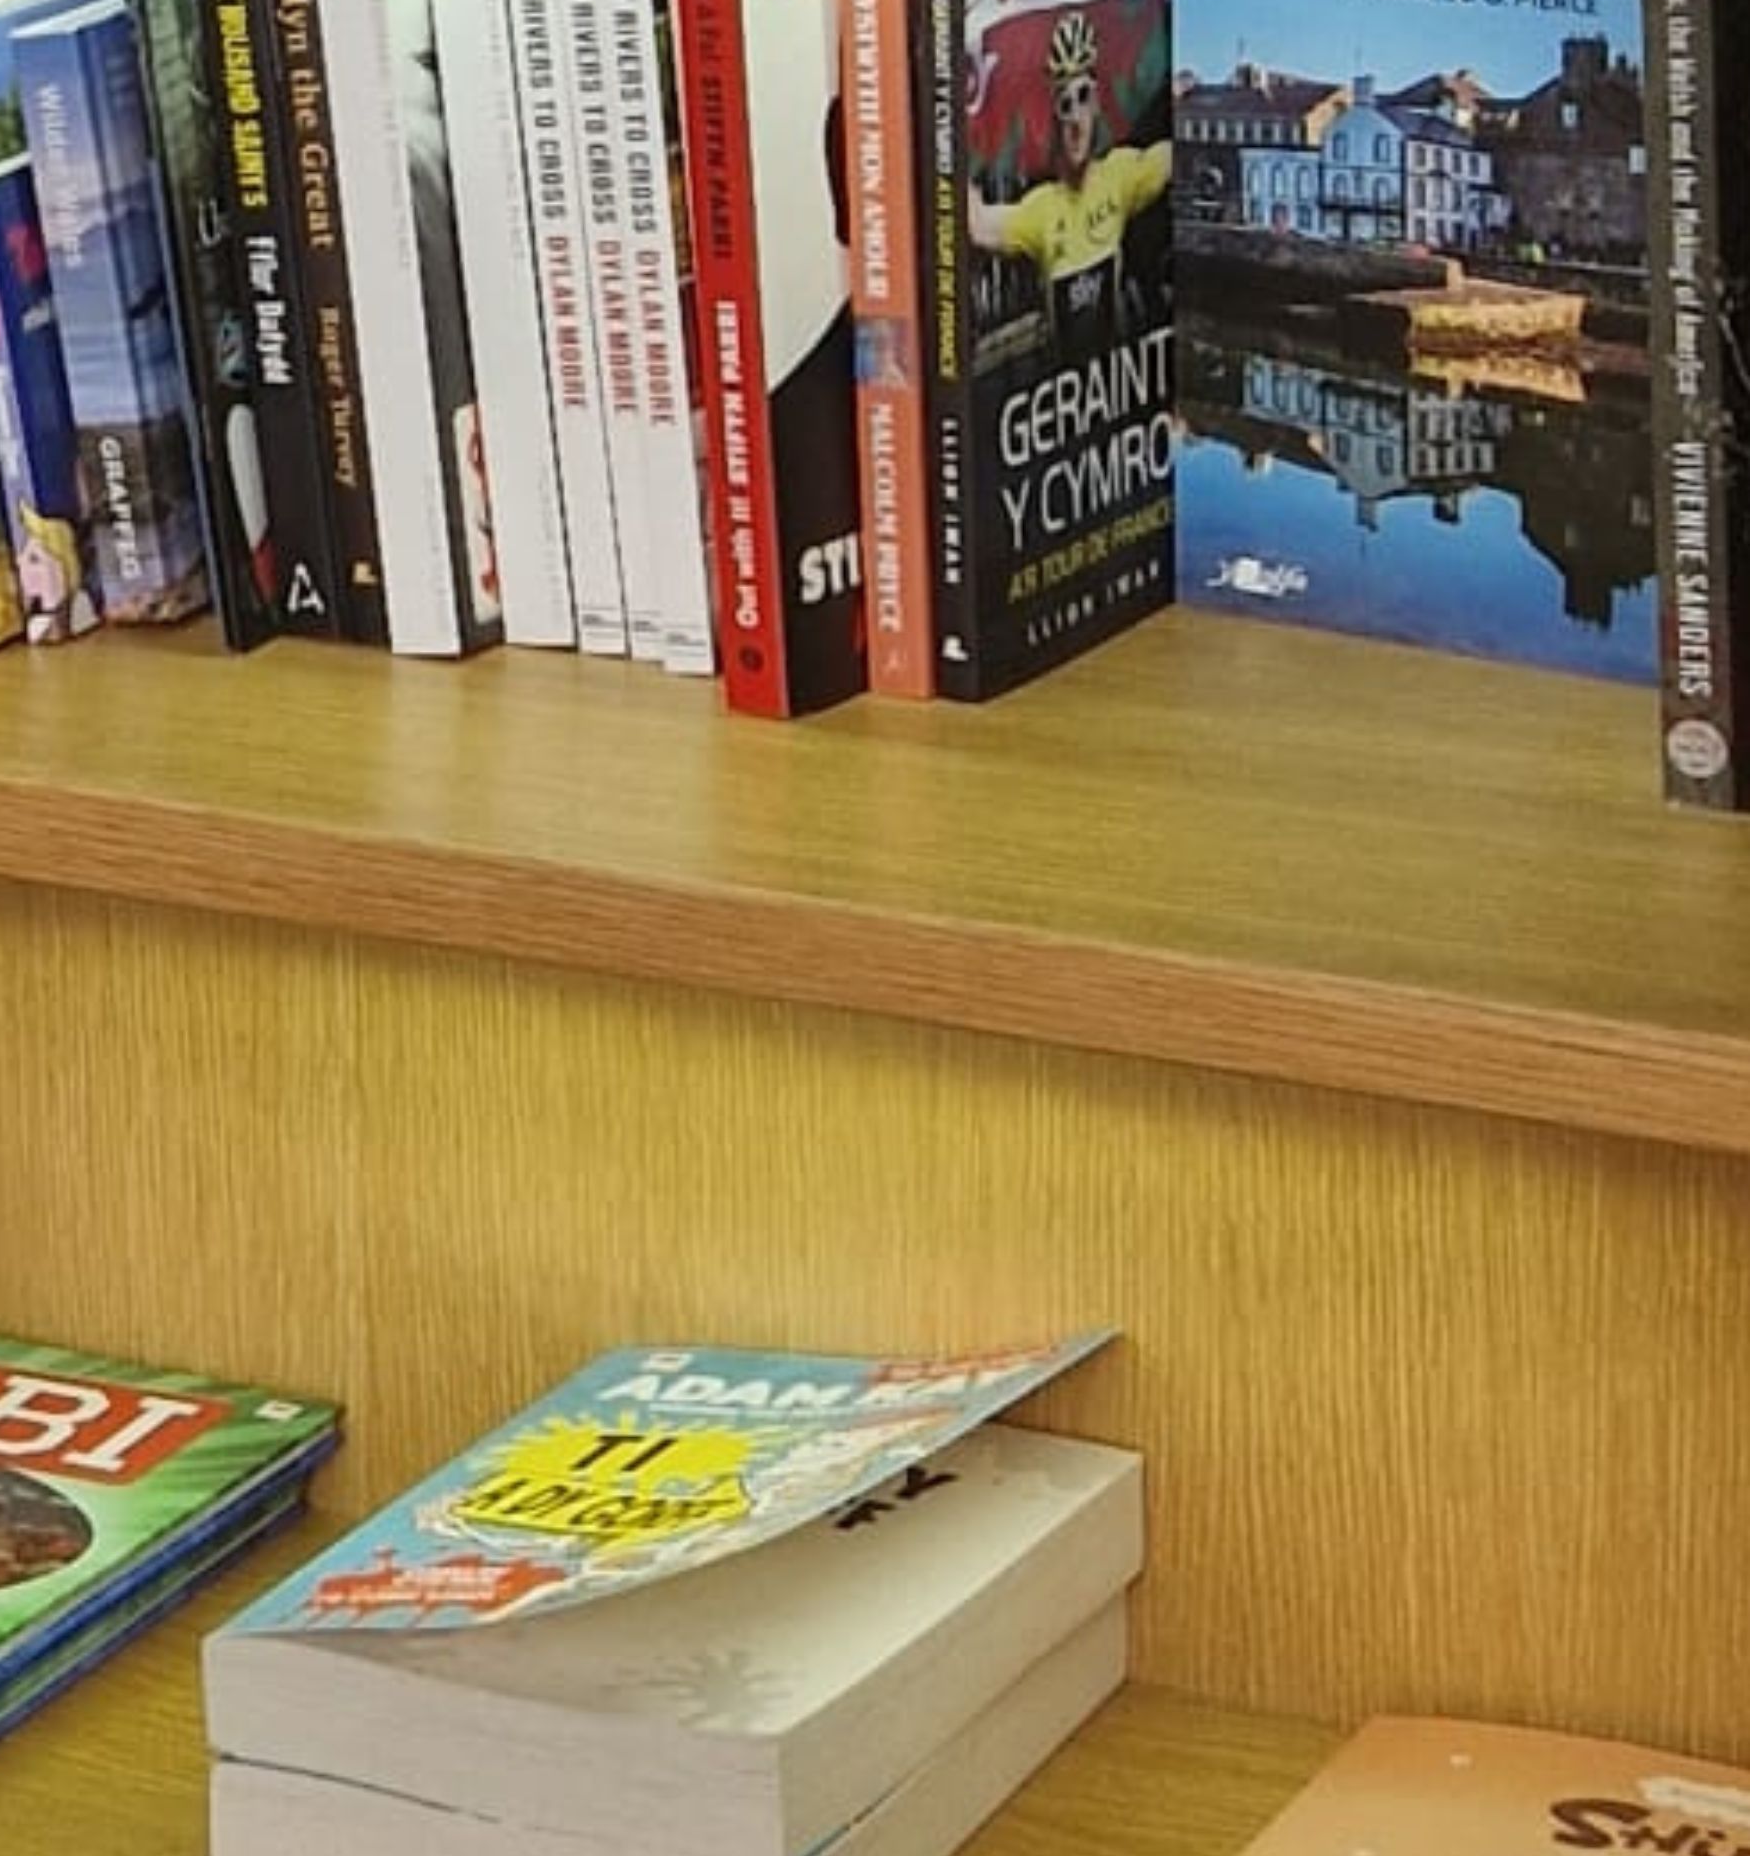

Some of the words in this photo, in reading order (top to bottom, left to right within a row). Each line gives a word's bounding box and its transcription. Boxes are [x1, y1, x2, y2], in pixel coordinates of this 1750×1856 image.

[570, 0, 603, 94] RIVERS
[611, 6, 646, 103] RIVERS
[1665, 16, 1695, 51] the
[289, 67, 324, 130] the
[530, 98, 560, 130] TO
[579, 101, 610, 135] TO
[620, 112, 649, 144] TO
[932, 85, 953, 98] Y
[1666, 56, 1698, 116] Welsh
[229, 116, 274, 208] SAINTS
[535, 134, 566, 219] CROSS
[585, 140, 617, 226] CROSS
[857, 129, 885, 191] MON
[1668, 122, 1698, 162] and
[1670, 166, 1699, 202] the
[297, 141, 338, 249] Great
[625, 148, 658, 236] CROSS
[542, 233, 578, 317] DYLAN
[595, 237, 630, 322] DYLAN
[859, 199, 890, 300] AMOUR
[1667, 209, 1702, 280] Making
[633, 247, 667, 333] DYLAN
[1674, 285, 1703, 308] of
[311, 305, 348, 388] Roger
[553, 323, 587, 412] MOORE
[604, 329, 639, 417] MOORE
[643, 339, 676, 426] MOORE
[713, 301, 743, 382] PARRI
[720, 391, 750, 484] STIFYN
[1002, 326, 1175, 467] GERAINT
[323, 397, 359, 490] Turvey
[868, 402, 901, 536] MALCOLM
[1002, 477, 1031, 552] Y
[1040, 411, 1175, 532] CYMRO
[97, 434, 142, 580] GRAFFEG
[1671, 439, 1710, 563] VIVIENNE
[730, 527, 756, 580] with
[873, 541, 905, 633] PRYCE
[1041, 540, 1084, 589] TOUR
[734, 582, 760, 628] Out
[1028, 594, 1095, 647] LLION
[1675, 573, 1713, 699] SANDERS
[599, 1374, 841, 1409] ADAM
[572, 1434, 675, 1472] TI
